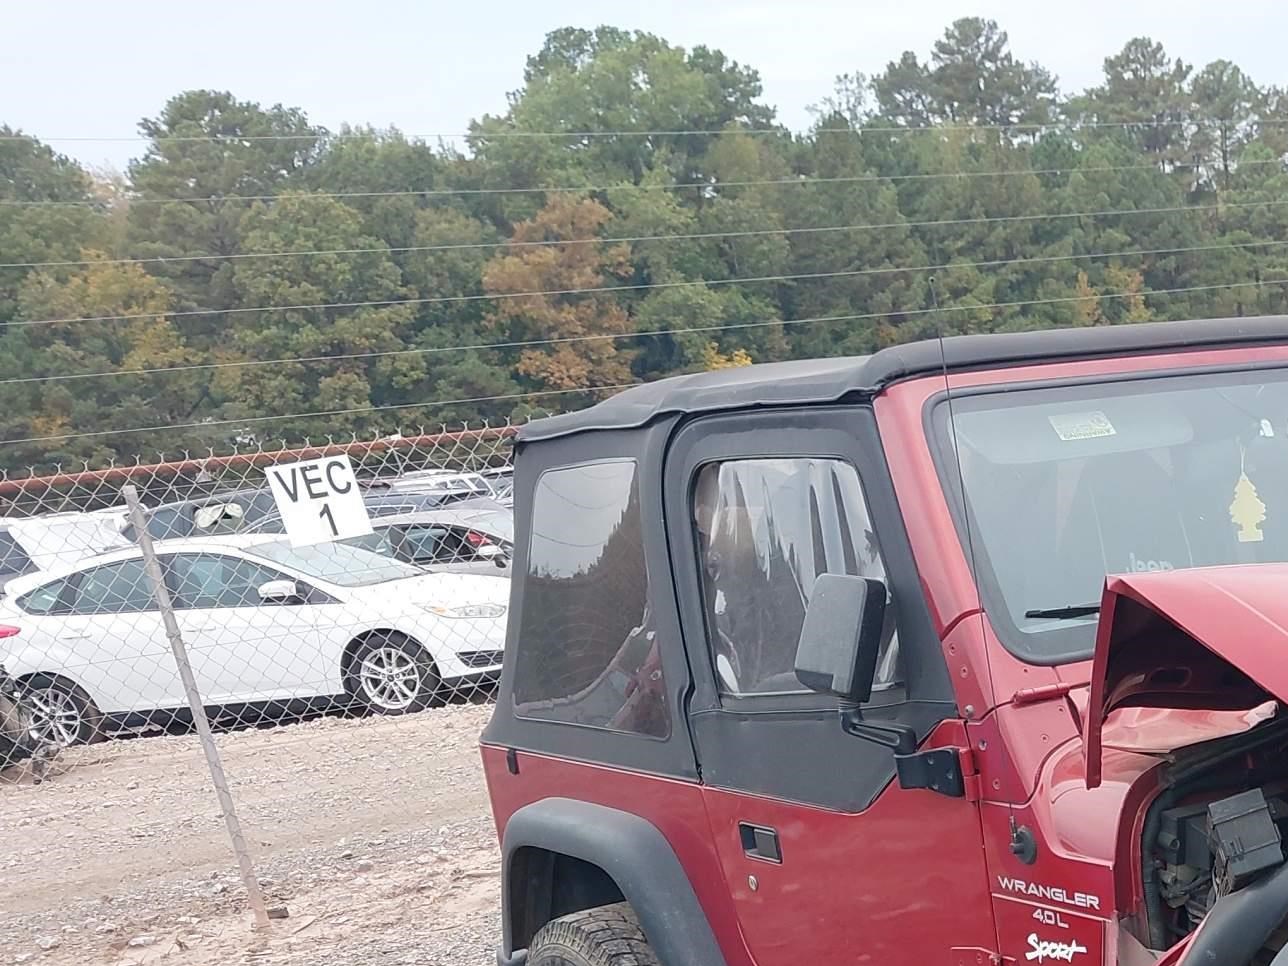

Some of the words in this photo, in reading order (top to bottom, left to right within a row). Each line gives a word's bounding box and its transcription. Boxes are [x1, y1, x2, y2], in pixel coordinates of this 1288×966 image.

[273, 460, 352, 503] VEC
[319, 503, 339, 537] 1
[997, 875, 1101, 911] WRANGLER
[1024, 932, 1088, 965] Sport
